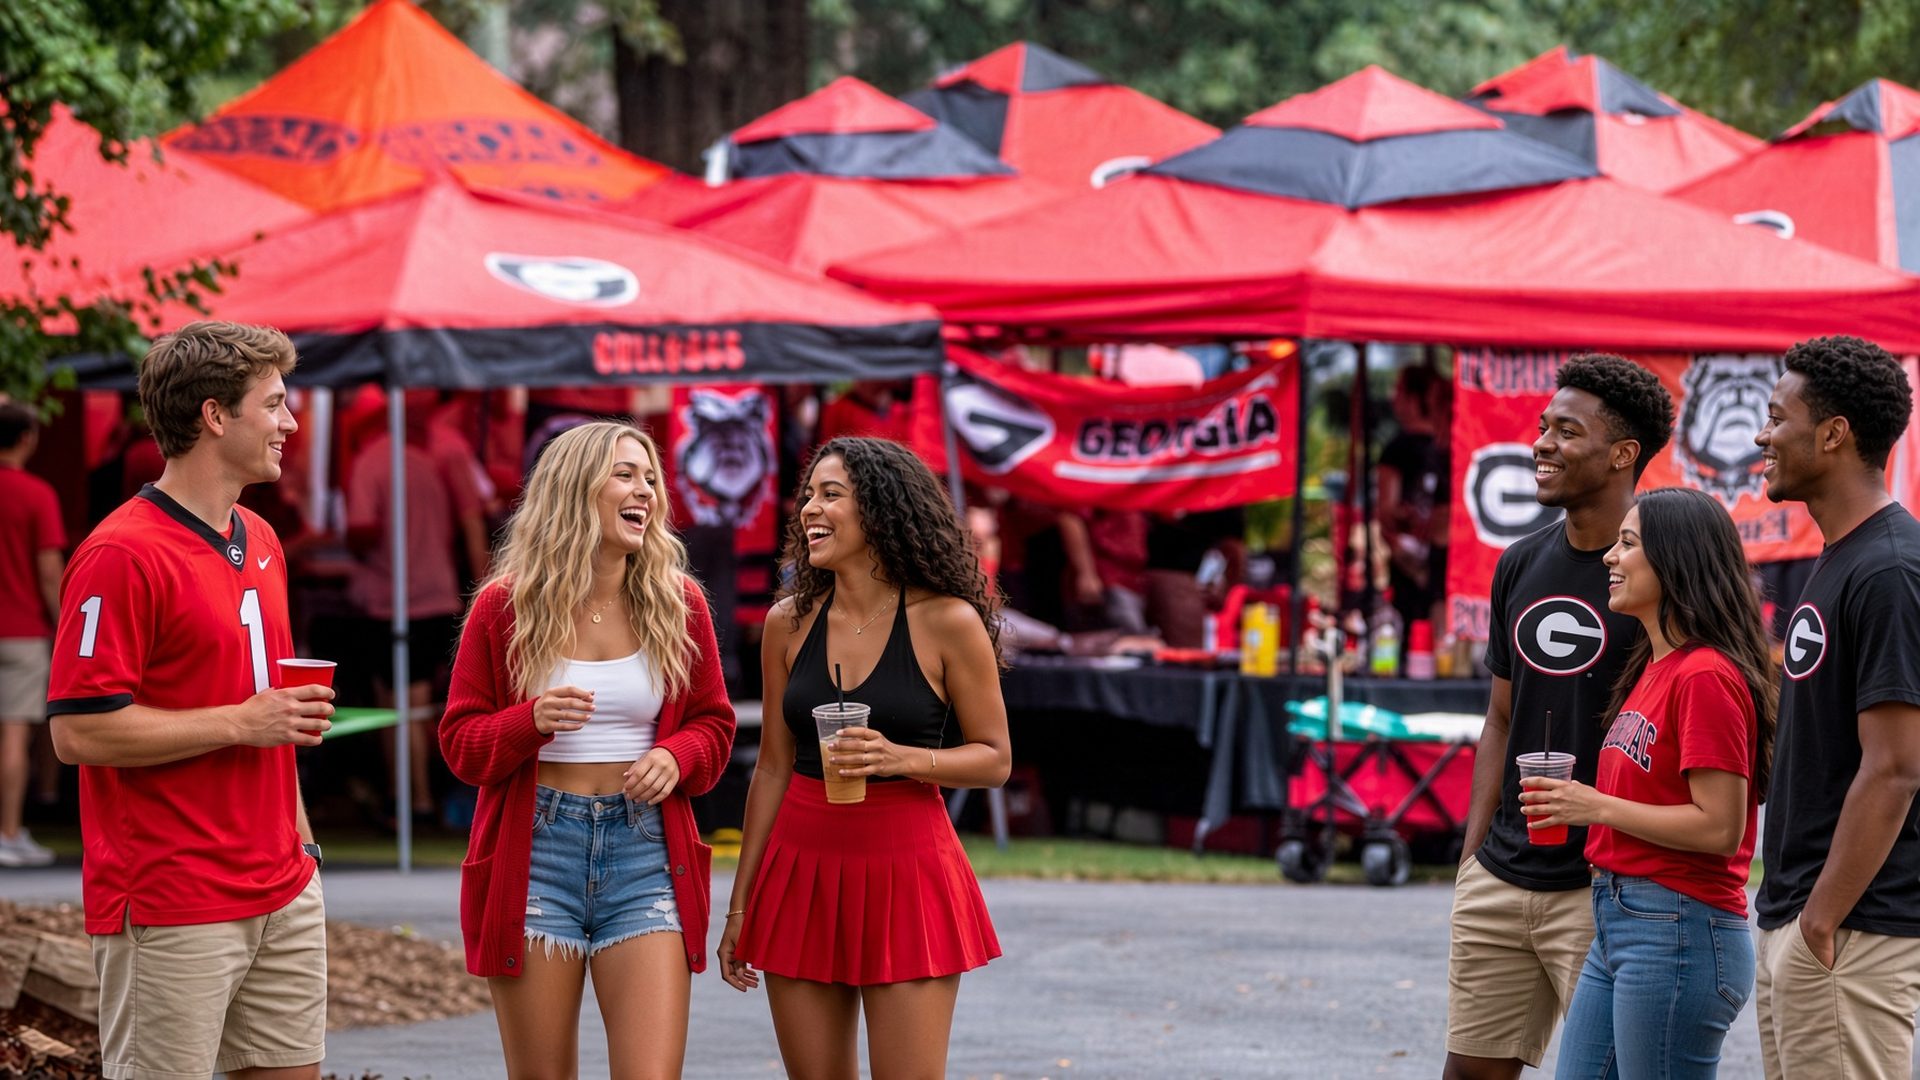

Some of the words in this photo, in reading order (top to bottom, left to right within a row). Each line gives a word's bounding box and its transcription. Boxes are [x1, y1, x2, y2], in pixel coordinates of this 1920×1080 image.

[1074, 396, 1278, 460] GEORGIA
[227, 545, 244, 565] G
[78, 595, 102, 658] 1
[235, 588, 271, 694] 1
[1515, 598, 1605, 673] G
[1784, 605, 1826, 678] G
